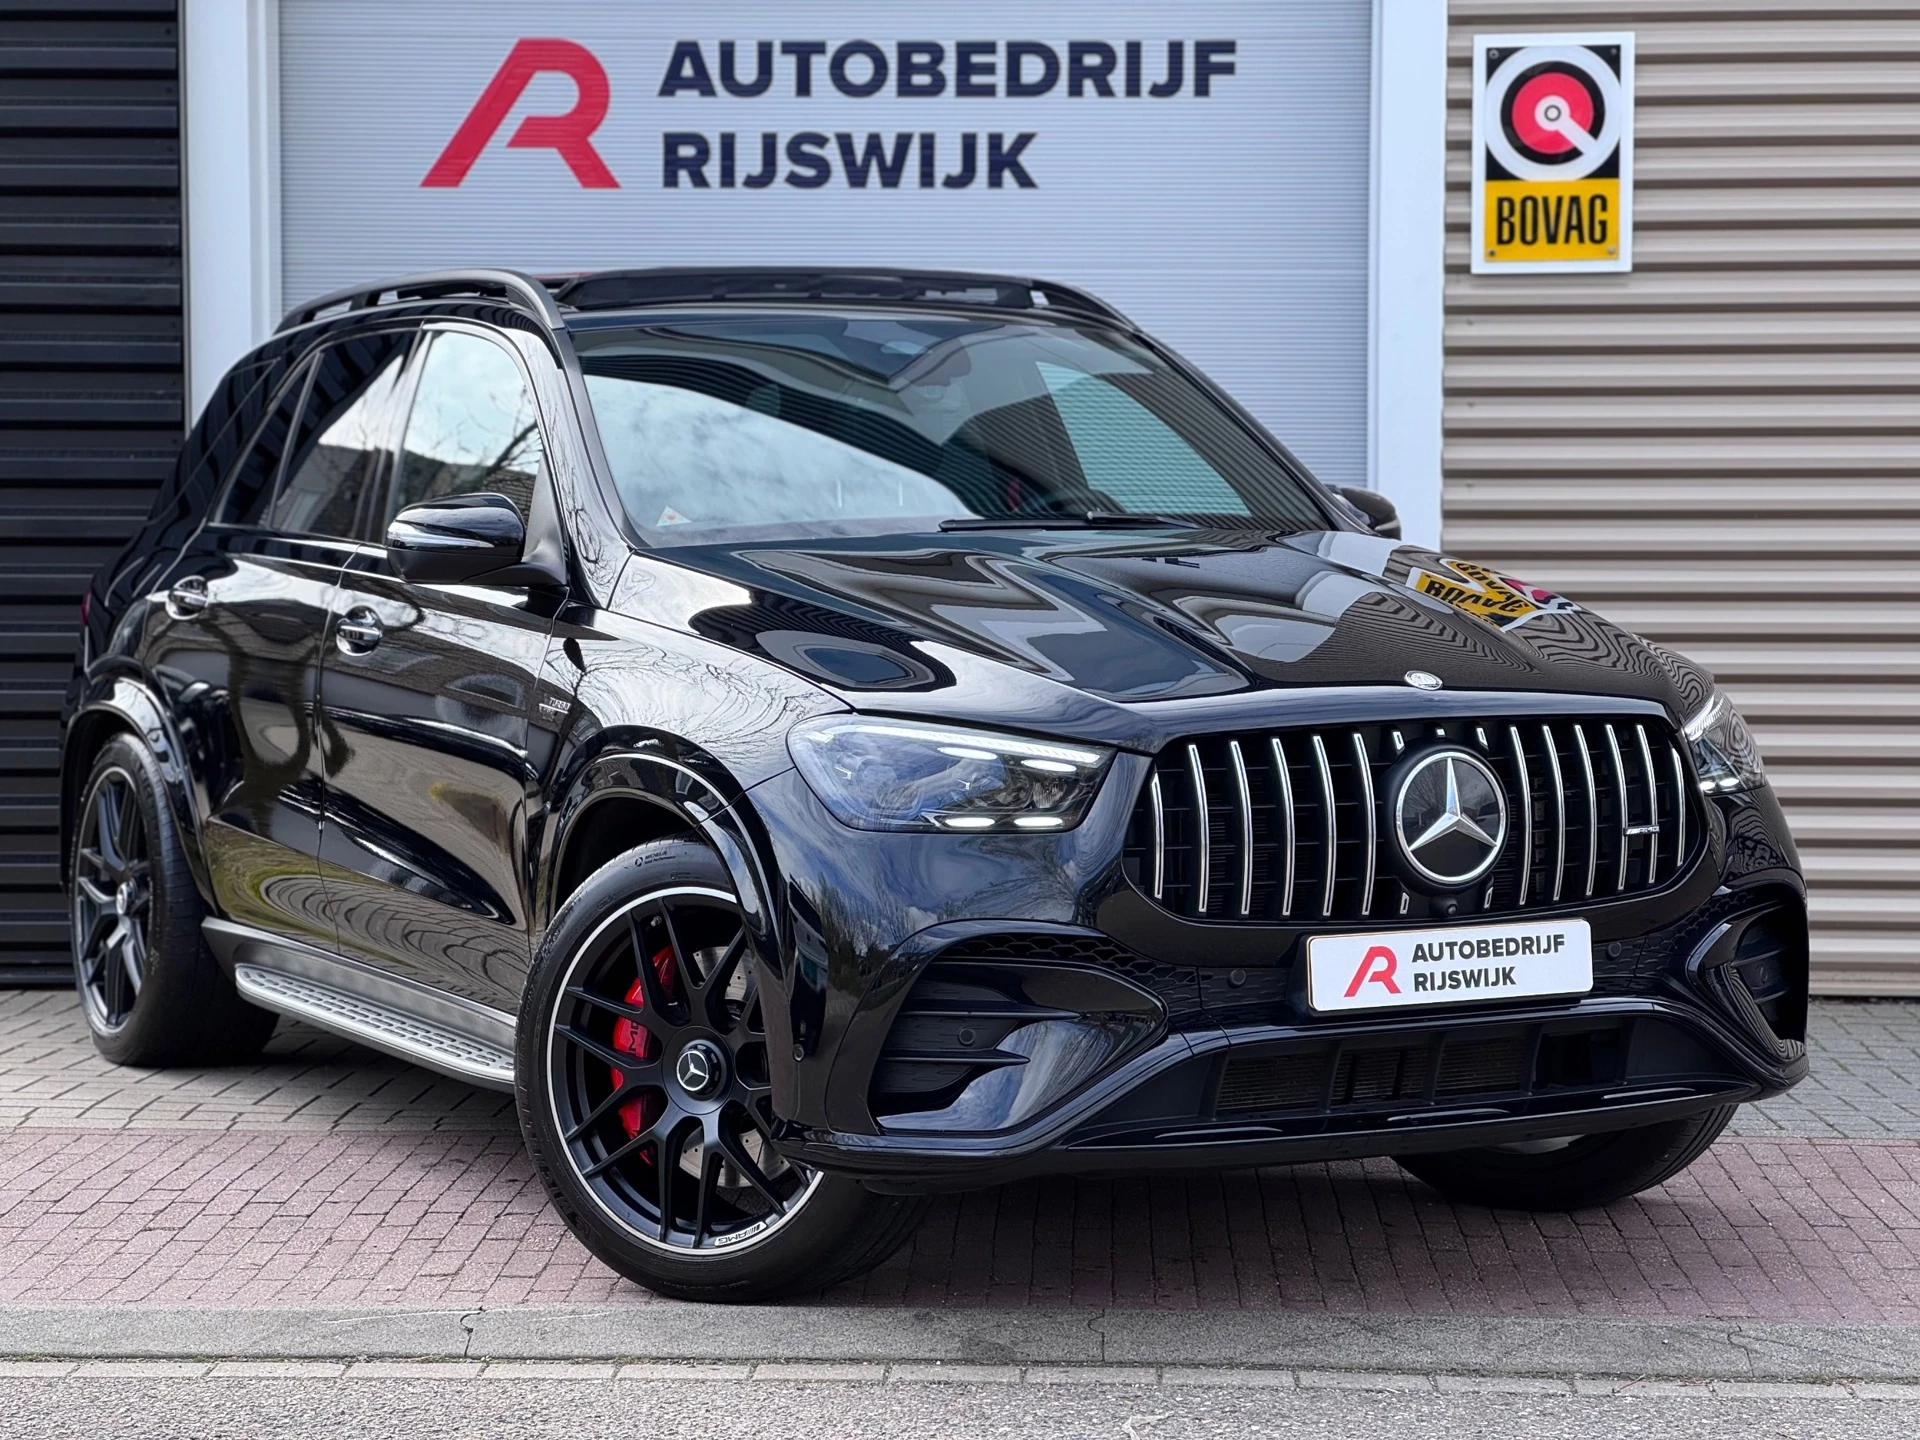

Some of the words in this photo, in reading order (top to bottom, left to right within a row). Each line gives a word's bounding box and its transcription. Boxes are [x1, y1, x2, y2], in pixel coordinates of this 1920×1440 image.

[658, 40, 1237, 98] AUTOBEDRIJF
[662, 132, 1038, 189] RIJSWIJK
[1497, 194, 1608, 246] BOVAG
[1412, 934, 1565, 963] AUTOBEDRIJF
[1413, 966, 1517, 992] RIJSWIJK
[717, 1229, 750, 1244] AMG
